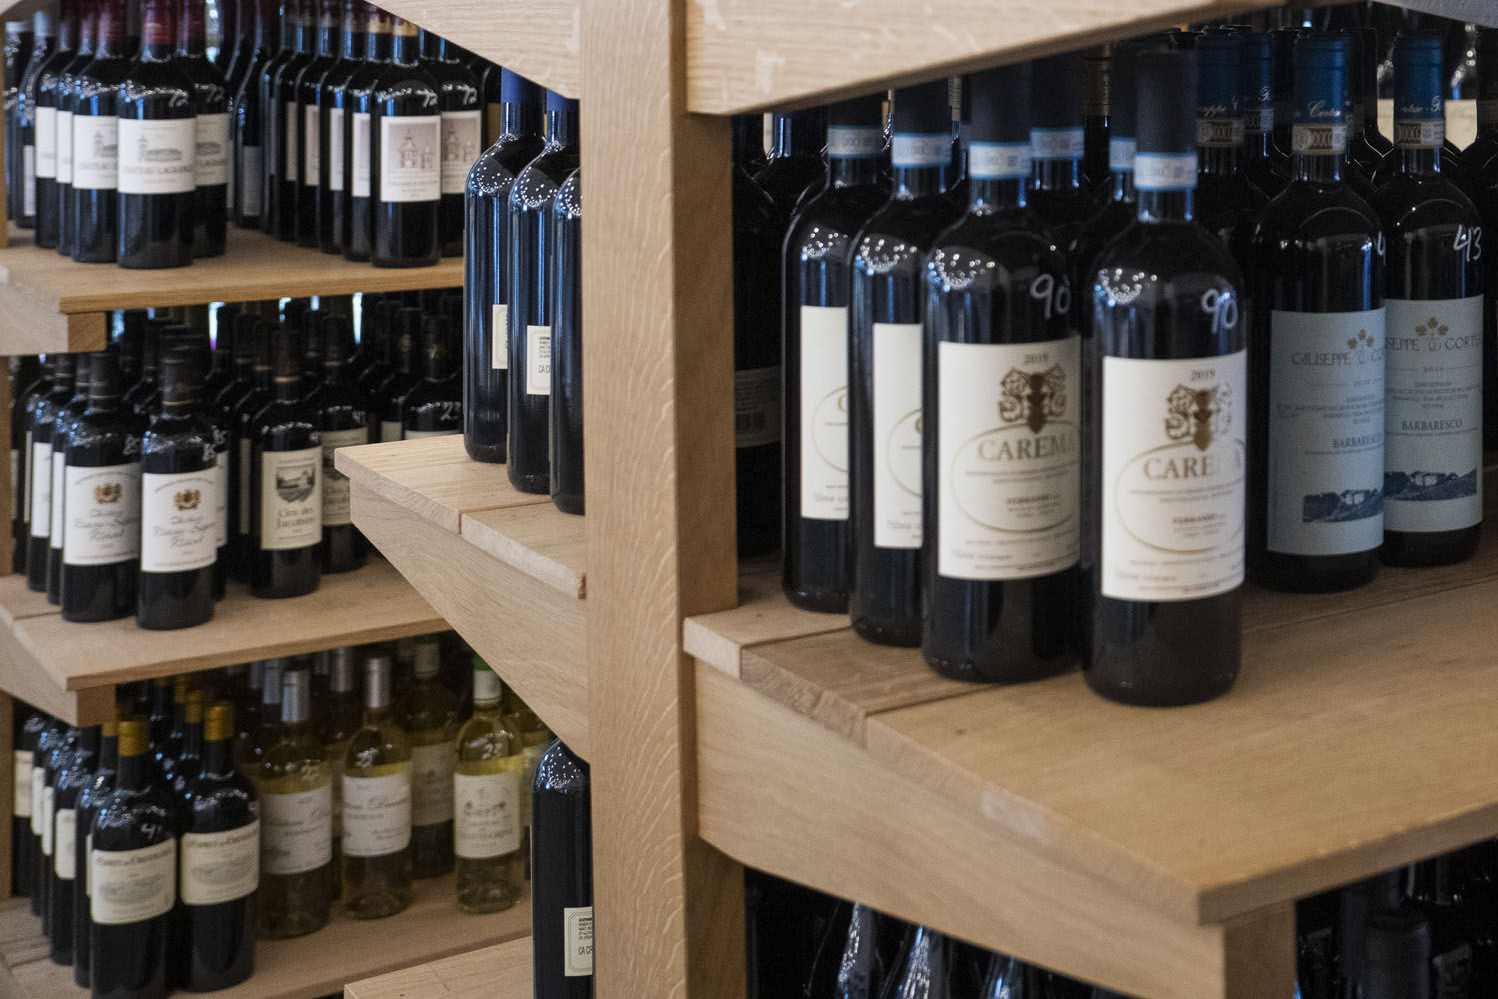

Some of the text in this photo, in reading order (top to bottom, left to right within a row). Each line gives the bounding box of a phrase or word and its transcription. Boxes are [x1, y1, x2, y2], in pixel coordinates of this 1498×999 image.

[1453, 224, 1482, 263] 43
[1030, 272, 1071, 320] 90
[1201, 288, 1239, 334] 90
[1401, 419, 1463, 431] BARBARESCO
[978, 432, 1077, 461] CAREM
[1144, 453, 1217, 480] CARE
